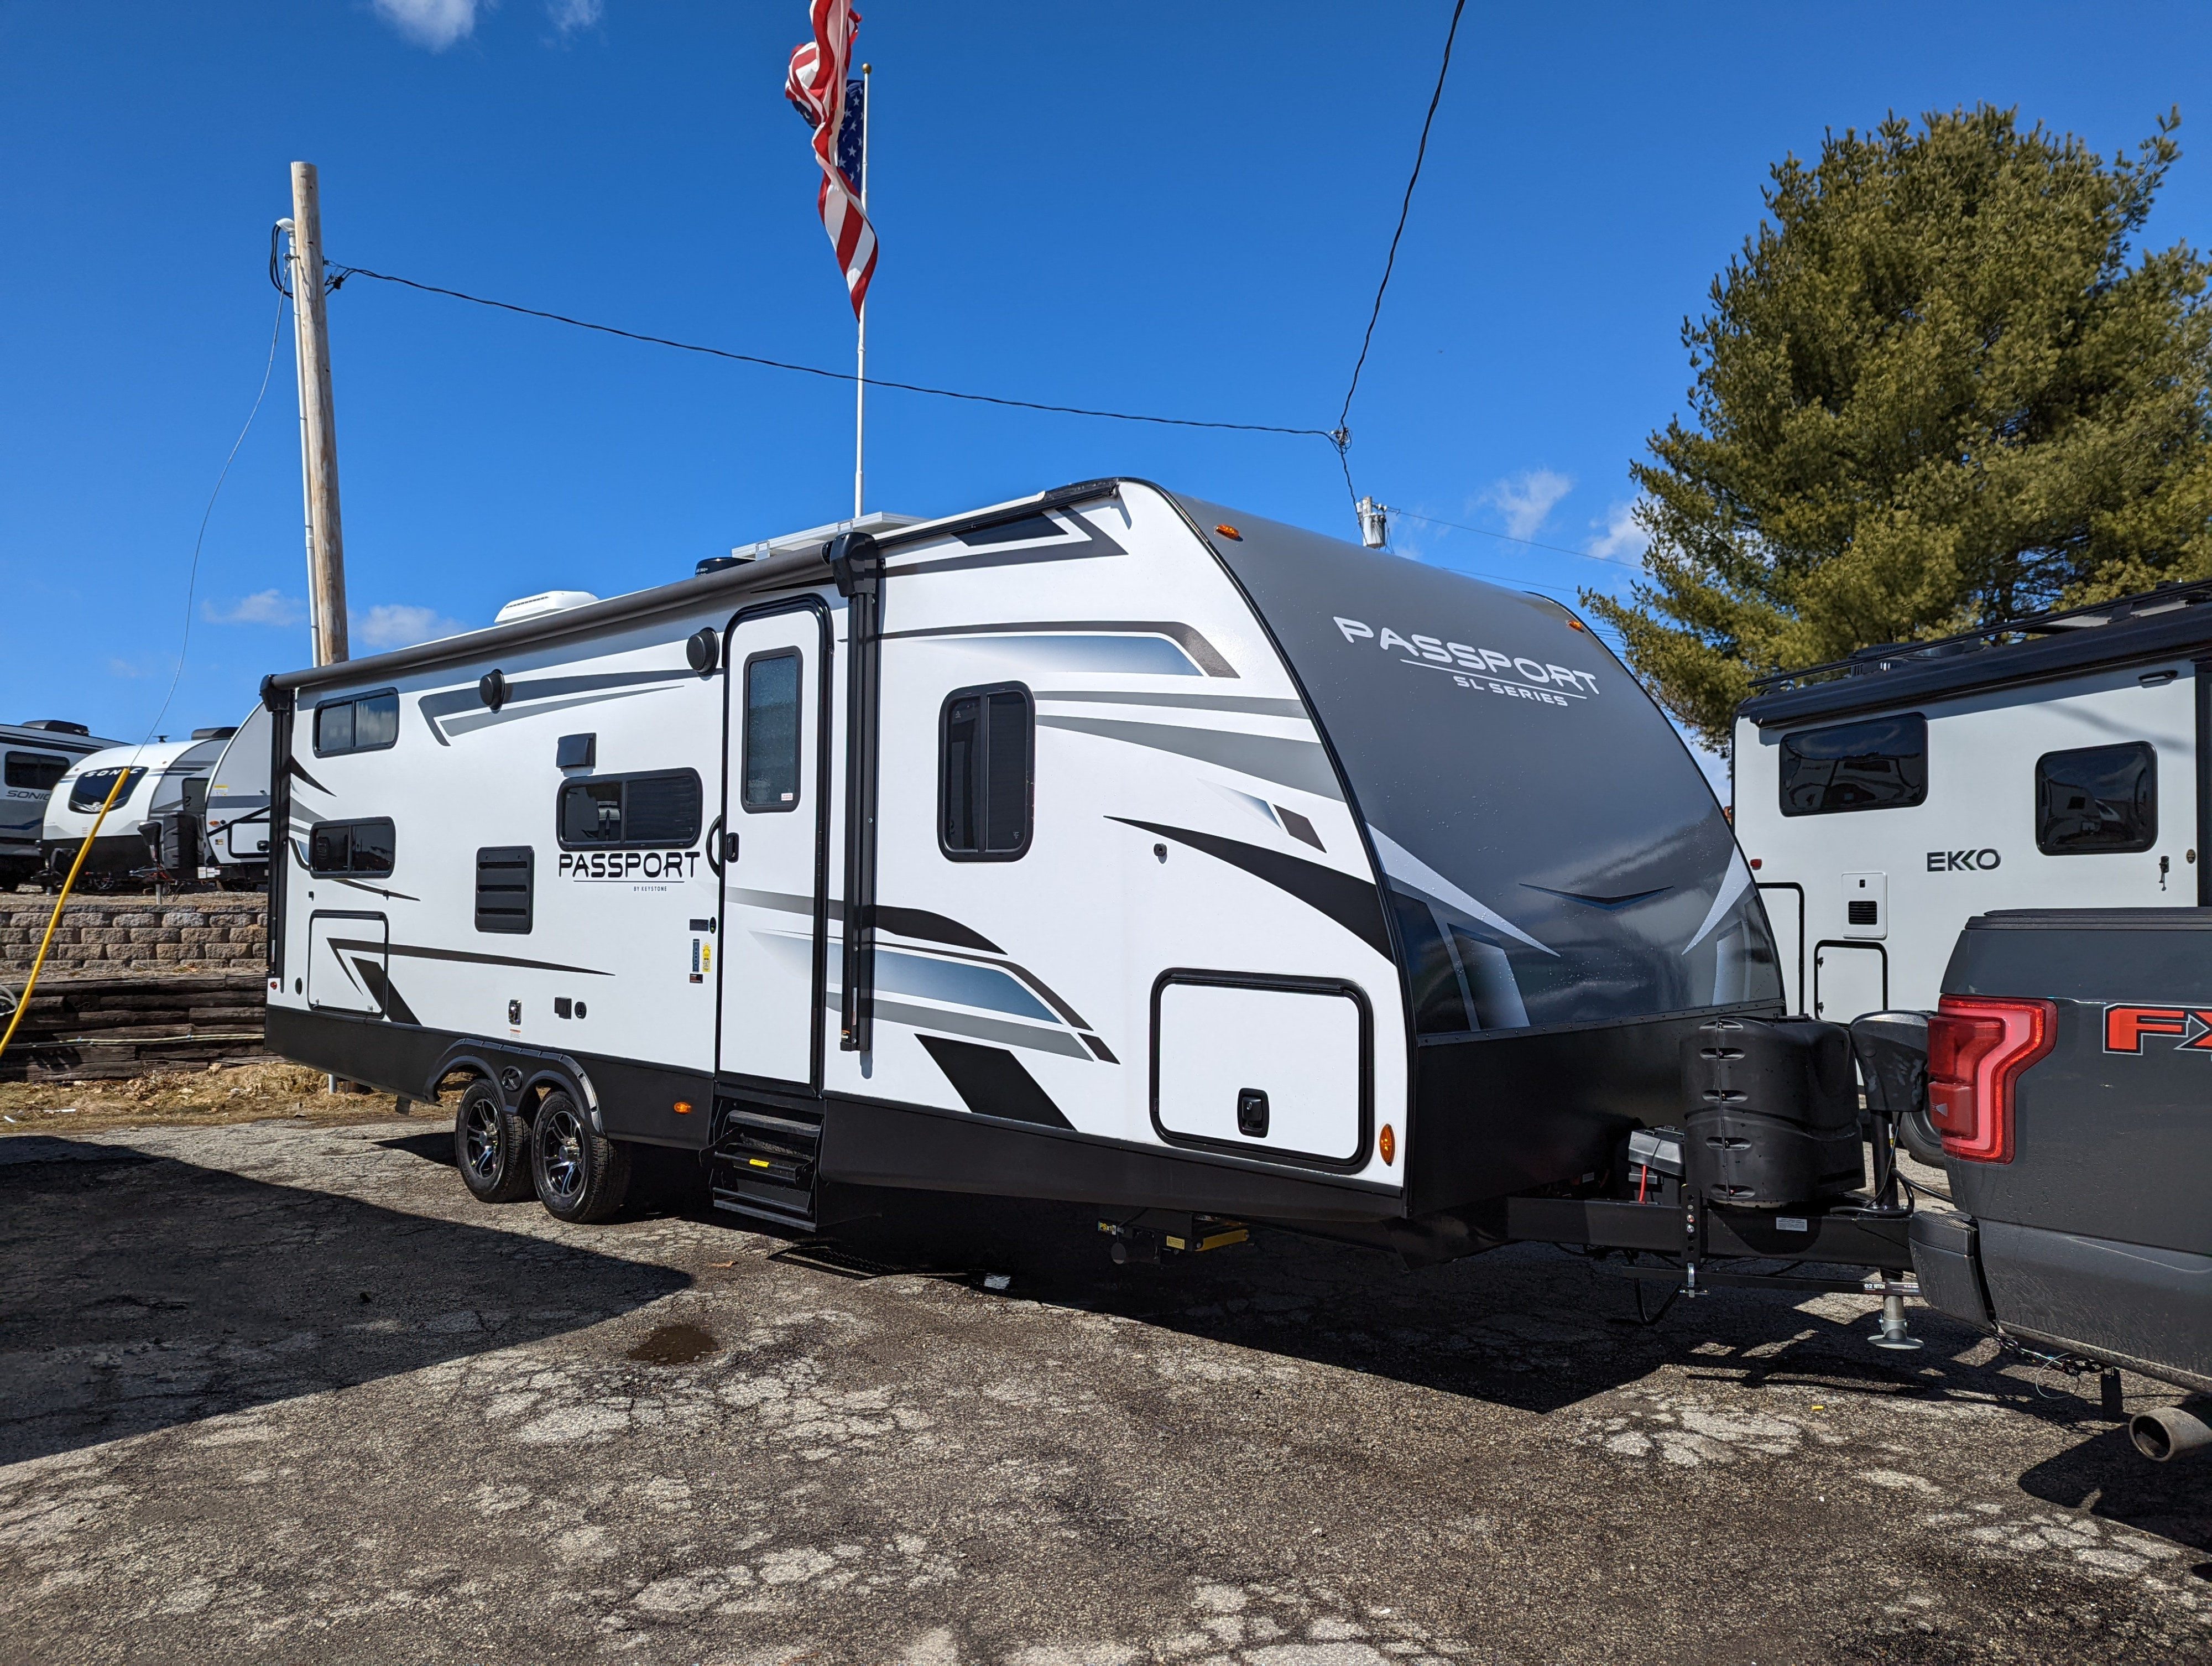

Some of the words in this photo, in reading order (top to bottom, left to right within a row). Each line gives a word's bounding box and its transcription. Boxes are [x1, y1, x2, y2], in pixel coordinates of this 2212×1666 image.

[1333, 616, 1600, 695] PASSPORT
[1453, 675, 1485, 691] SL
[1489, 683, 1568, 707] SERIES
[85, 768, 142, 777] SONC
[559, 852, 701, 878] PASSPORT
[1927, 848, 2001, 872] EKKO
